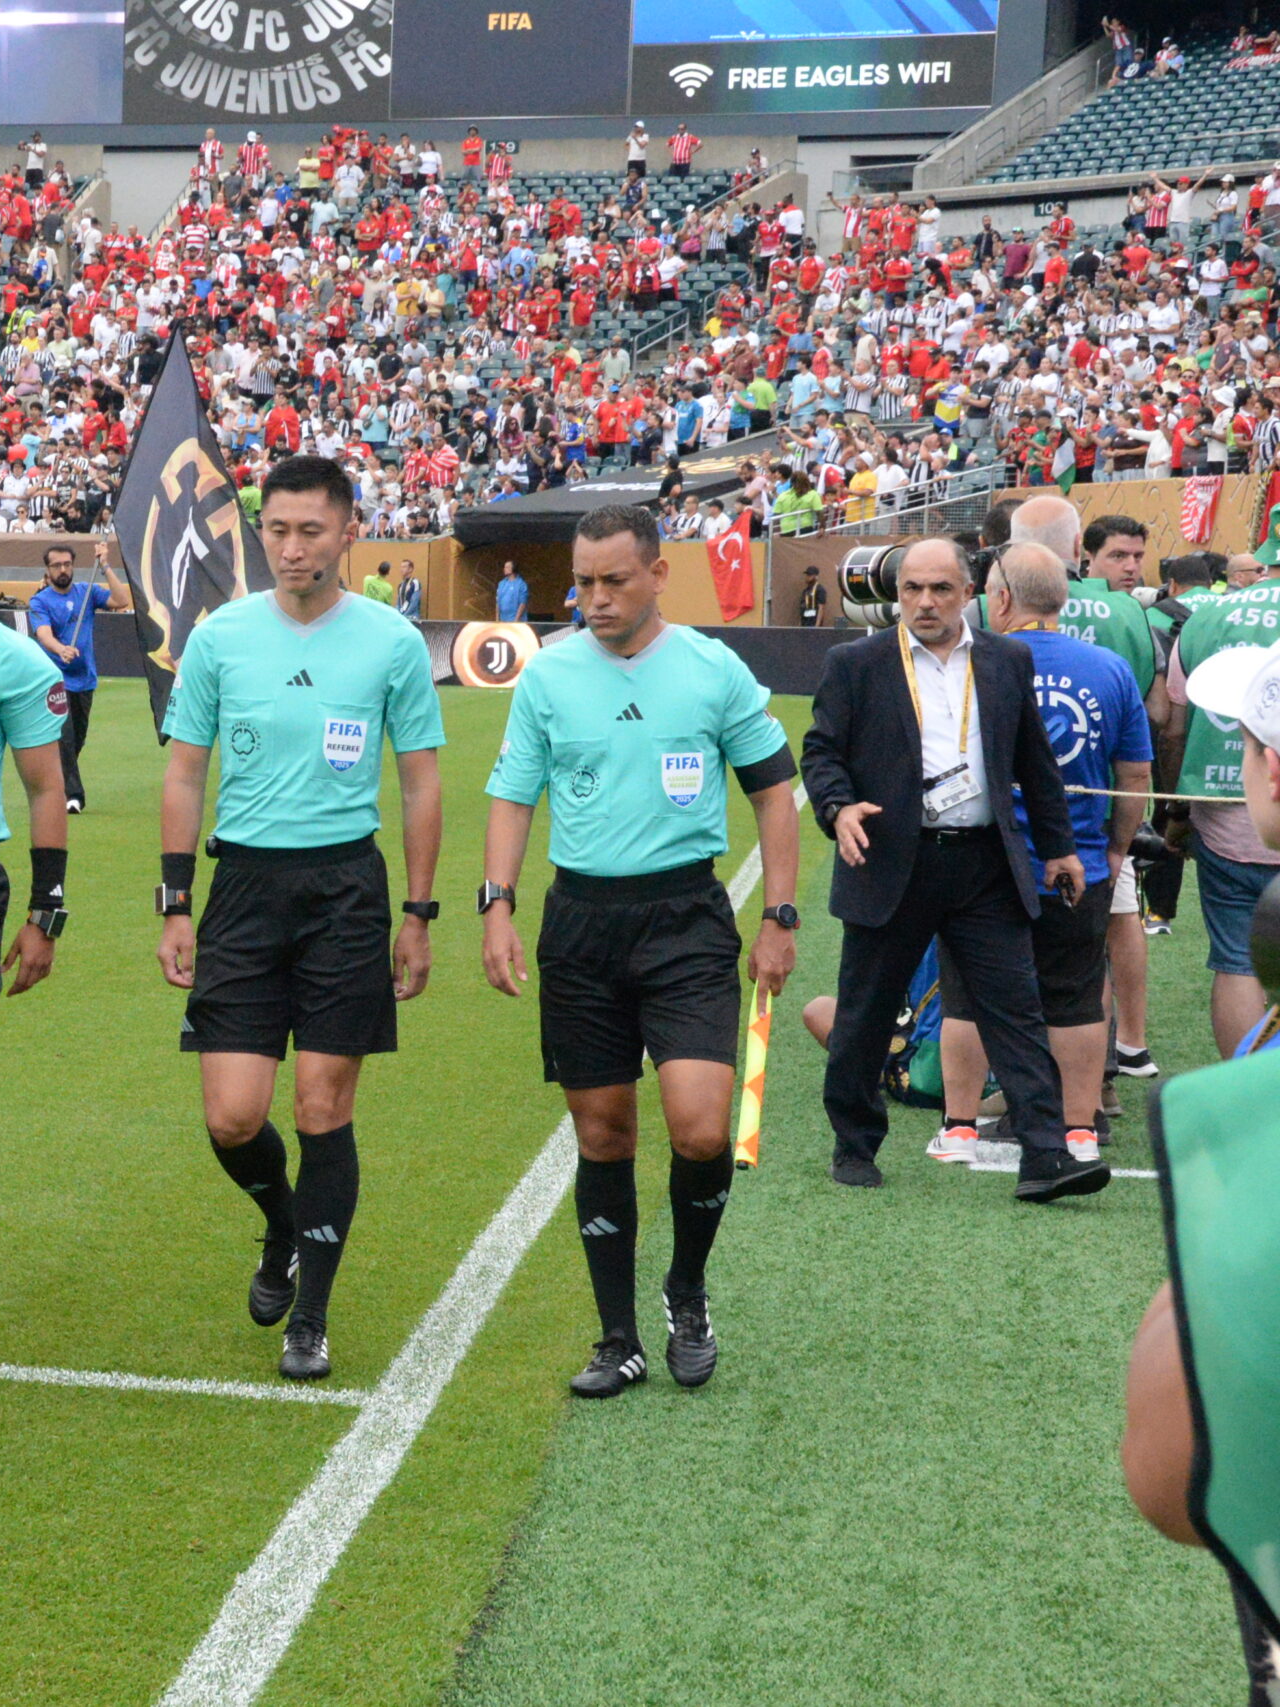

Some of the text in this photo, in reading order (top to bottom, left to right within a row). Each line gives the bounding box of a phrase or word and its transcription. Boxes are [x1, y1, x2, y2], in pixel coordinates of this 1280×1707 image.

[243, 8, 291, 52] FC
[488, 12, 533, 31] FIFA
[160, 52, 341, 114] JUVENTUS
[337, 41, 392, 92] FC
[728, 61, 951, 90] FREE EAGLES WIFI
[489, 141, 516, 153] 19
[1217, 585, 1280, 607] PHOT
[1059, 598, 1111, 619] OTO
[1226, 607, 1279, 628] 456
[1033, 674, 1072, 689] RLD
[328, 722, 363, 737] FIFA
[326, 742, 361, 753] REFEREE
[1225, 740, 1245, 751] FIF
[665, 756, 701, 770] FIFA
